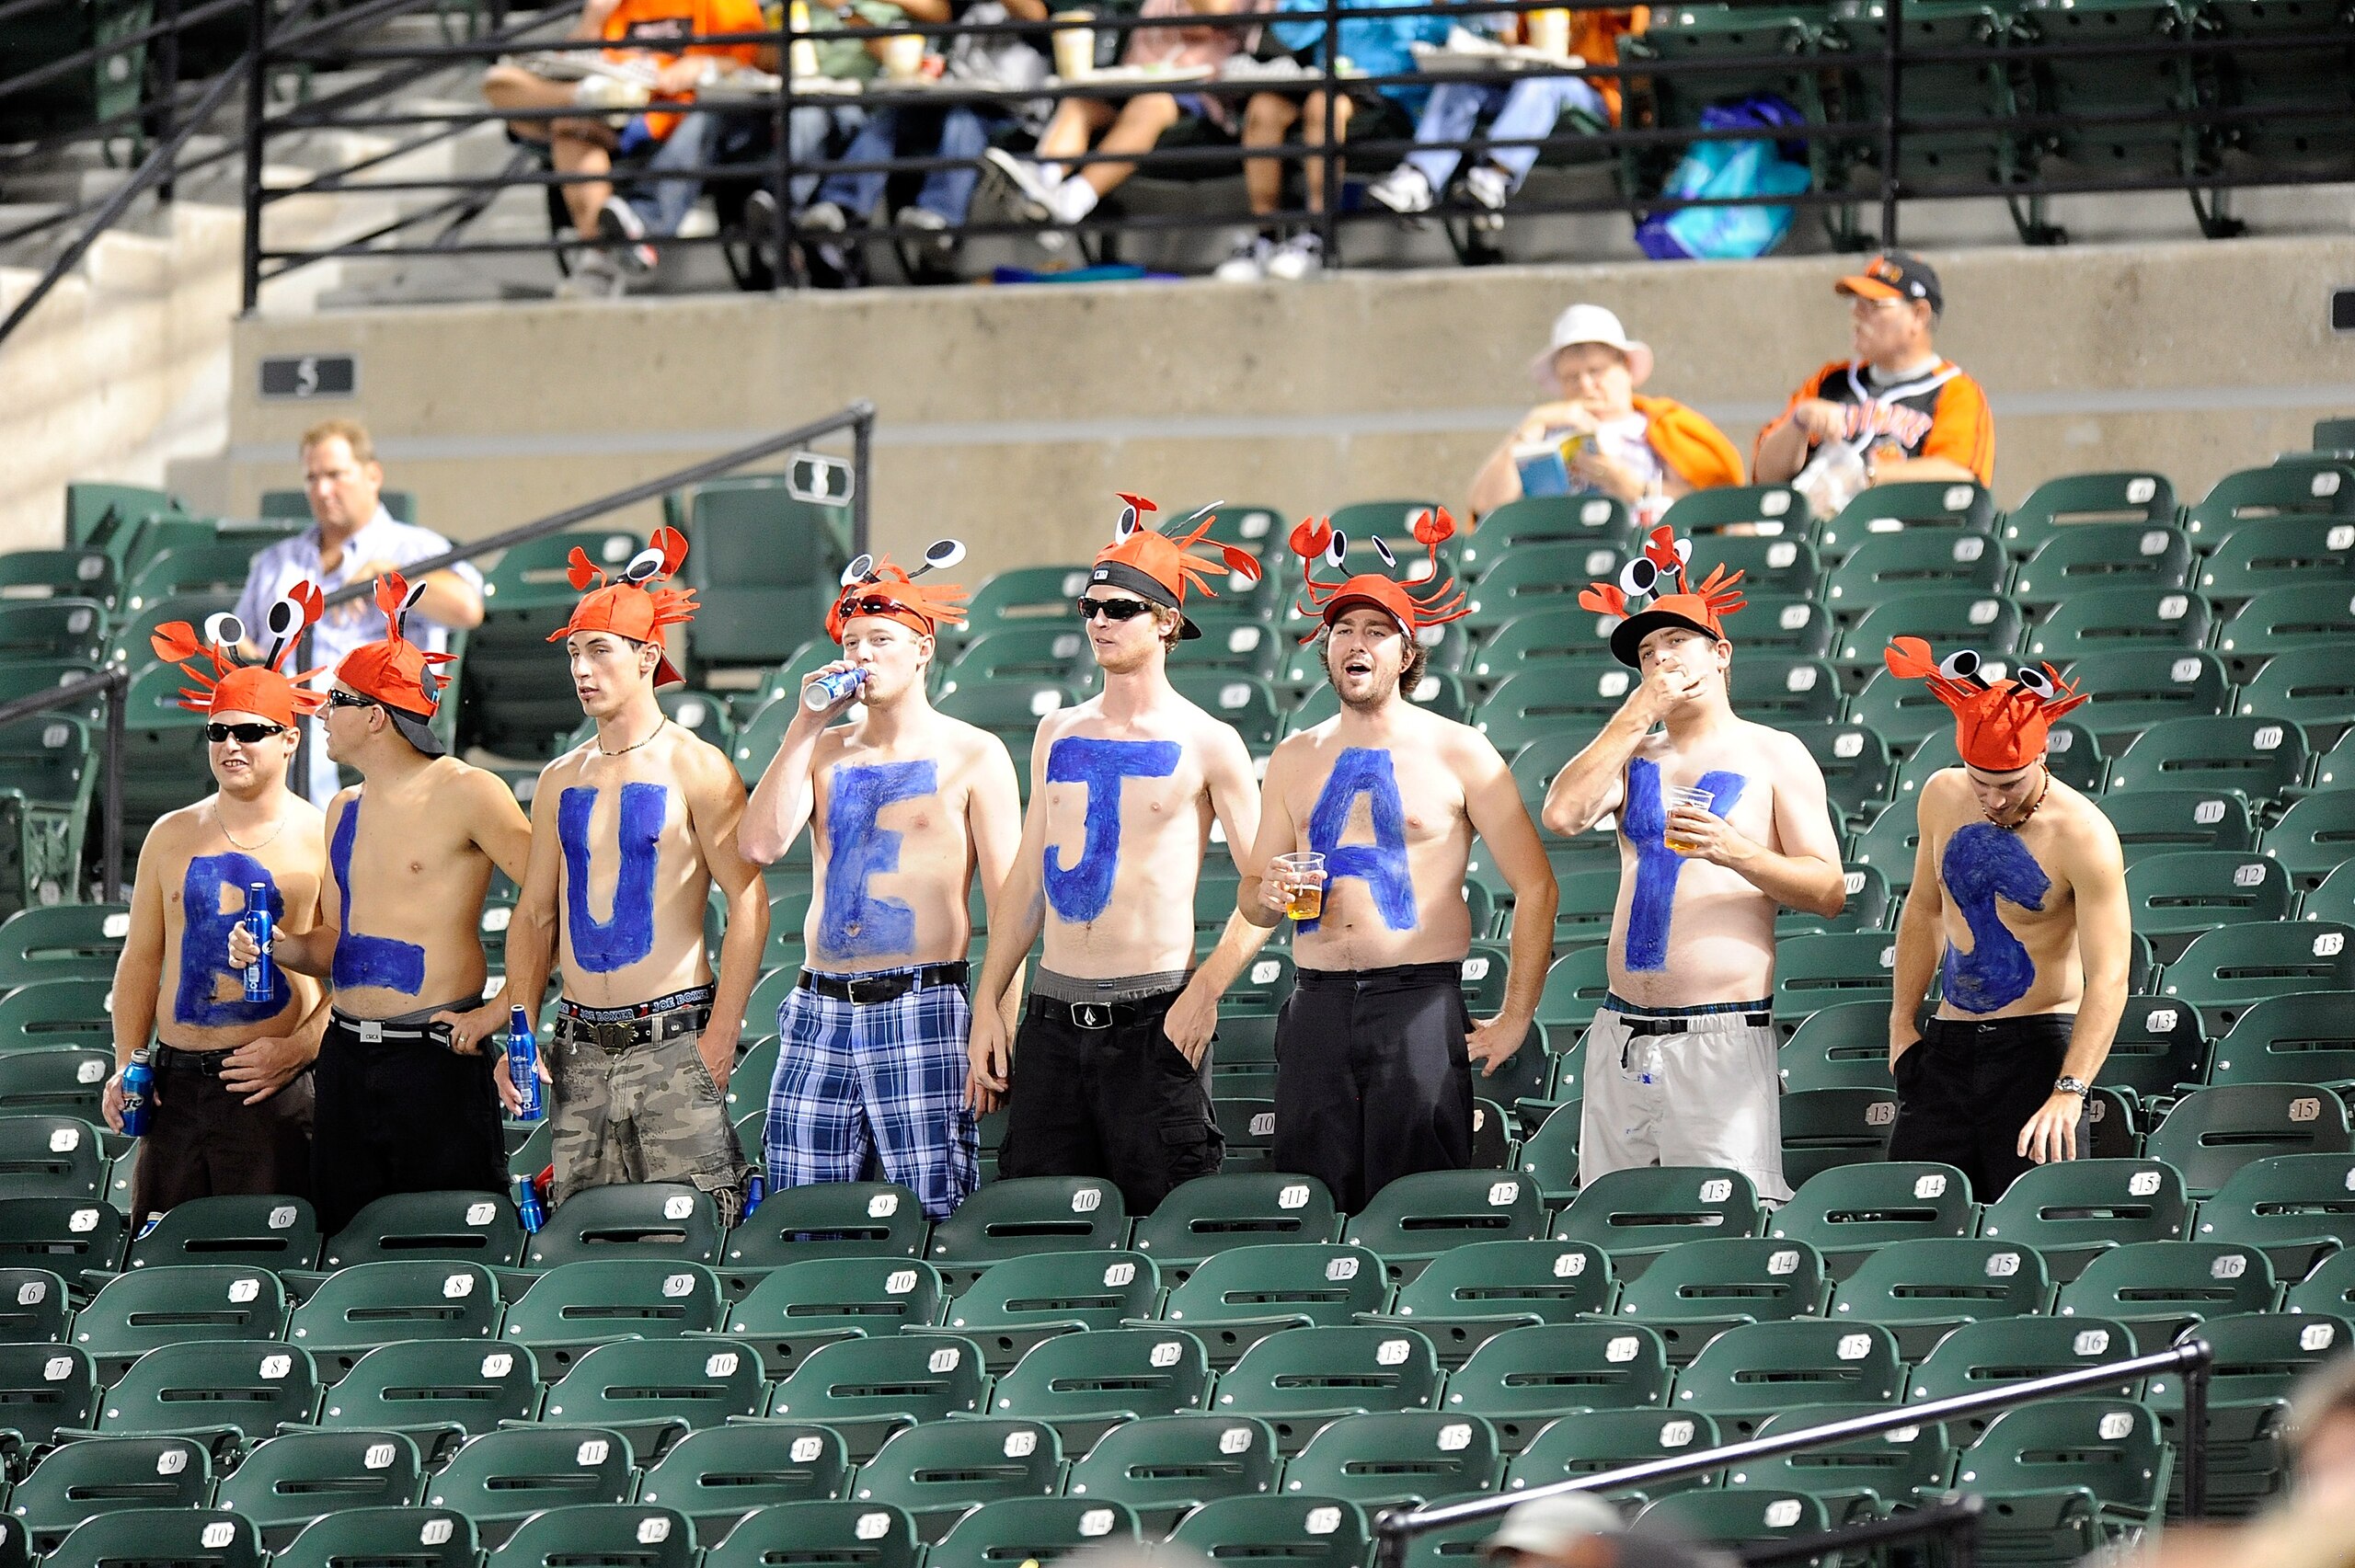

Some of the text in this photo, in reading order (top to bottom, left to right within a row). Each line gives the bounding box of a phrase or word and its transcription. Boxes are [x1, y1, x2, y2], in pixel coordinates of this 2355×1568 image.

[2338, 532, 2346, 544] 8
[2169, 601, 2177, 614] 8
[2183, 663, 2192, 677] 9
[1799, 672, 1809, 687] 7
[1844, 739, 1853, 752] 8
[2055, 734, 2063, 749] 9
[2261, 731, 2277, 747] 10
[2203, 805, 2217, 819] 11
[175, 737, 2052, 1026] B L U E J A Y S
[1844, 876, 1860, 890] 10
[2243, 867, 2259, 883] 12
[2322, 936, 2338, 953] 13
[1261, 967, 1271, 979] 8
[1469, 963, 1479, 977] 9
[652, 990, 709, 1013] JOE BOXER
[580, 1008, 596, 1021] JOE
[595, 1008, 635, 1022] BOXER
[2154, 1013, 2171, 1030] 13
[86, 1064, 96, 1081] 3
[1874, 1105, 1890, 1122] 13
[2297, 1101, 2314, 1118] 15
[1258, 1116, 1274, 1132] 10
[60, 1133, 69, 1148] 4
[1708, 1183, 1725, 1199] 13
[1924, 1179, 1939, 1195] 14
[2139, 1175, 2154, 1192] 15
[1079, 1193, 1096, 1209] 10
[1287, 1189, 1301, 1205] 11
[1497, 1185, 1513, 1202] 12
[674, 1202, 683, 1215] 8
[879, 1198, 889, 1212] 9
[78, 1213, 89, 1229] 5
[278, 1210, 287, 1226] 6
[477, 1206, 487, 1222] 7
[1335, 1261, 1352, 1277] 12
[1563, 1257, 1580, 1273] 13
[1776, 1256, 1793, 1271] 14
[1994, 1256, 2013, 1273] 15
[2221, 1259, 2239, 1275] 16
[894, 1275, 911, 1290] 10
[1113, 1267, 1127, 1283] 11
[241, 1282, 249, 1299] 7
[454, 1280, 462, 1294] 8
[674, 1277, 684, 1293] 9
[28, 1286, 37, 1302] 6
[2083, 1335, 2102, 1352] 16
[2310, 1328, 2328, 1345] 17
[1159, 1346, 1176, 1363] 12
[1386, 1345, 1403, 1361] 13
[1616, 1343, 1632, 1358] 14
[1847, 1339, 1864, 1356] 15
[55, 1360, 64, 1377] 7
[270, 1359, 281, 1375] 8
[493, 1358, 502, 1372] 9
[714, 1357, 732, 1373] 10
[937, 1353, 951, 1368] 11
[1671, 1426, 1687, 1443] 16
[2110, 1419, 2126, 1434] 18
[1014, 1436, 1030, 1453] 13
[1230, 1434, 1246, 1449] 14
[1447, 1429, 1465, 1447] 15
[373, 1448, 390, 1465] 10
[586, 1445, 601, 1461] 11
[799, 1441, 816, 1458] 12
[168, 1454, 178, 1471] 9
[211, 1528, 228, 1543] 10
[430, 1524, 445, 1541] 11
[648, 1522, 664, 1539] 12
